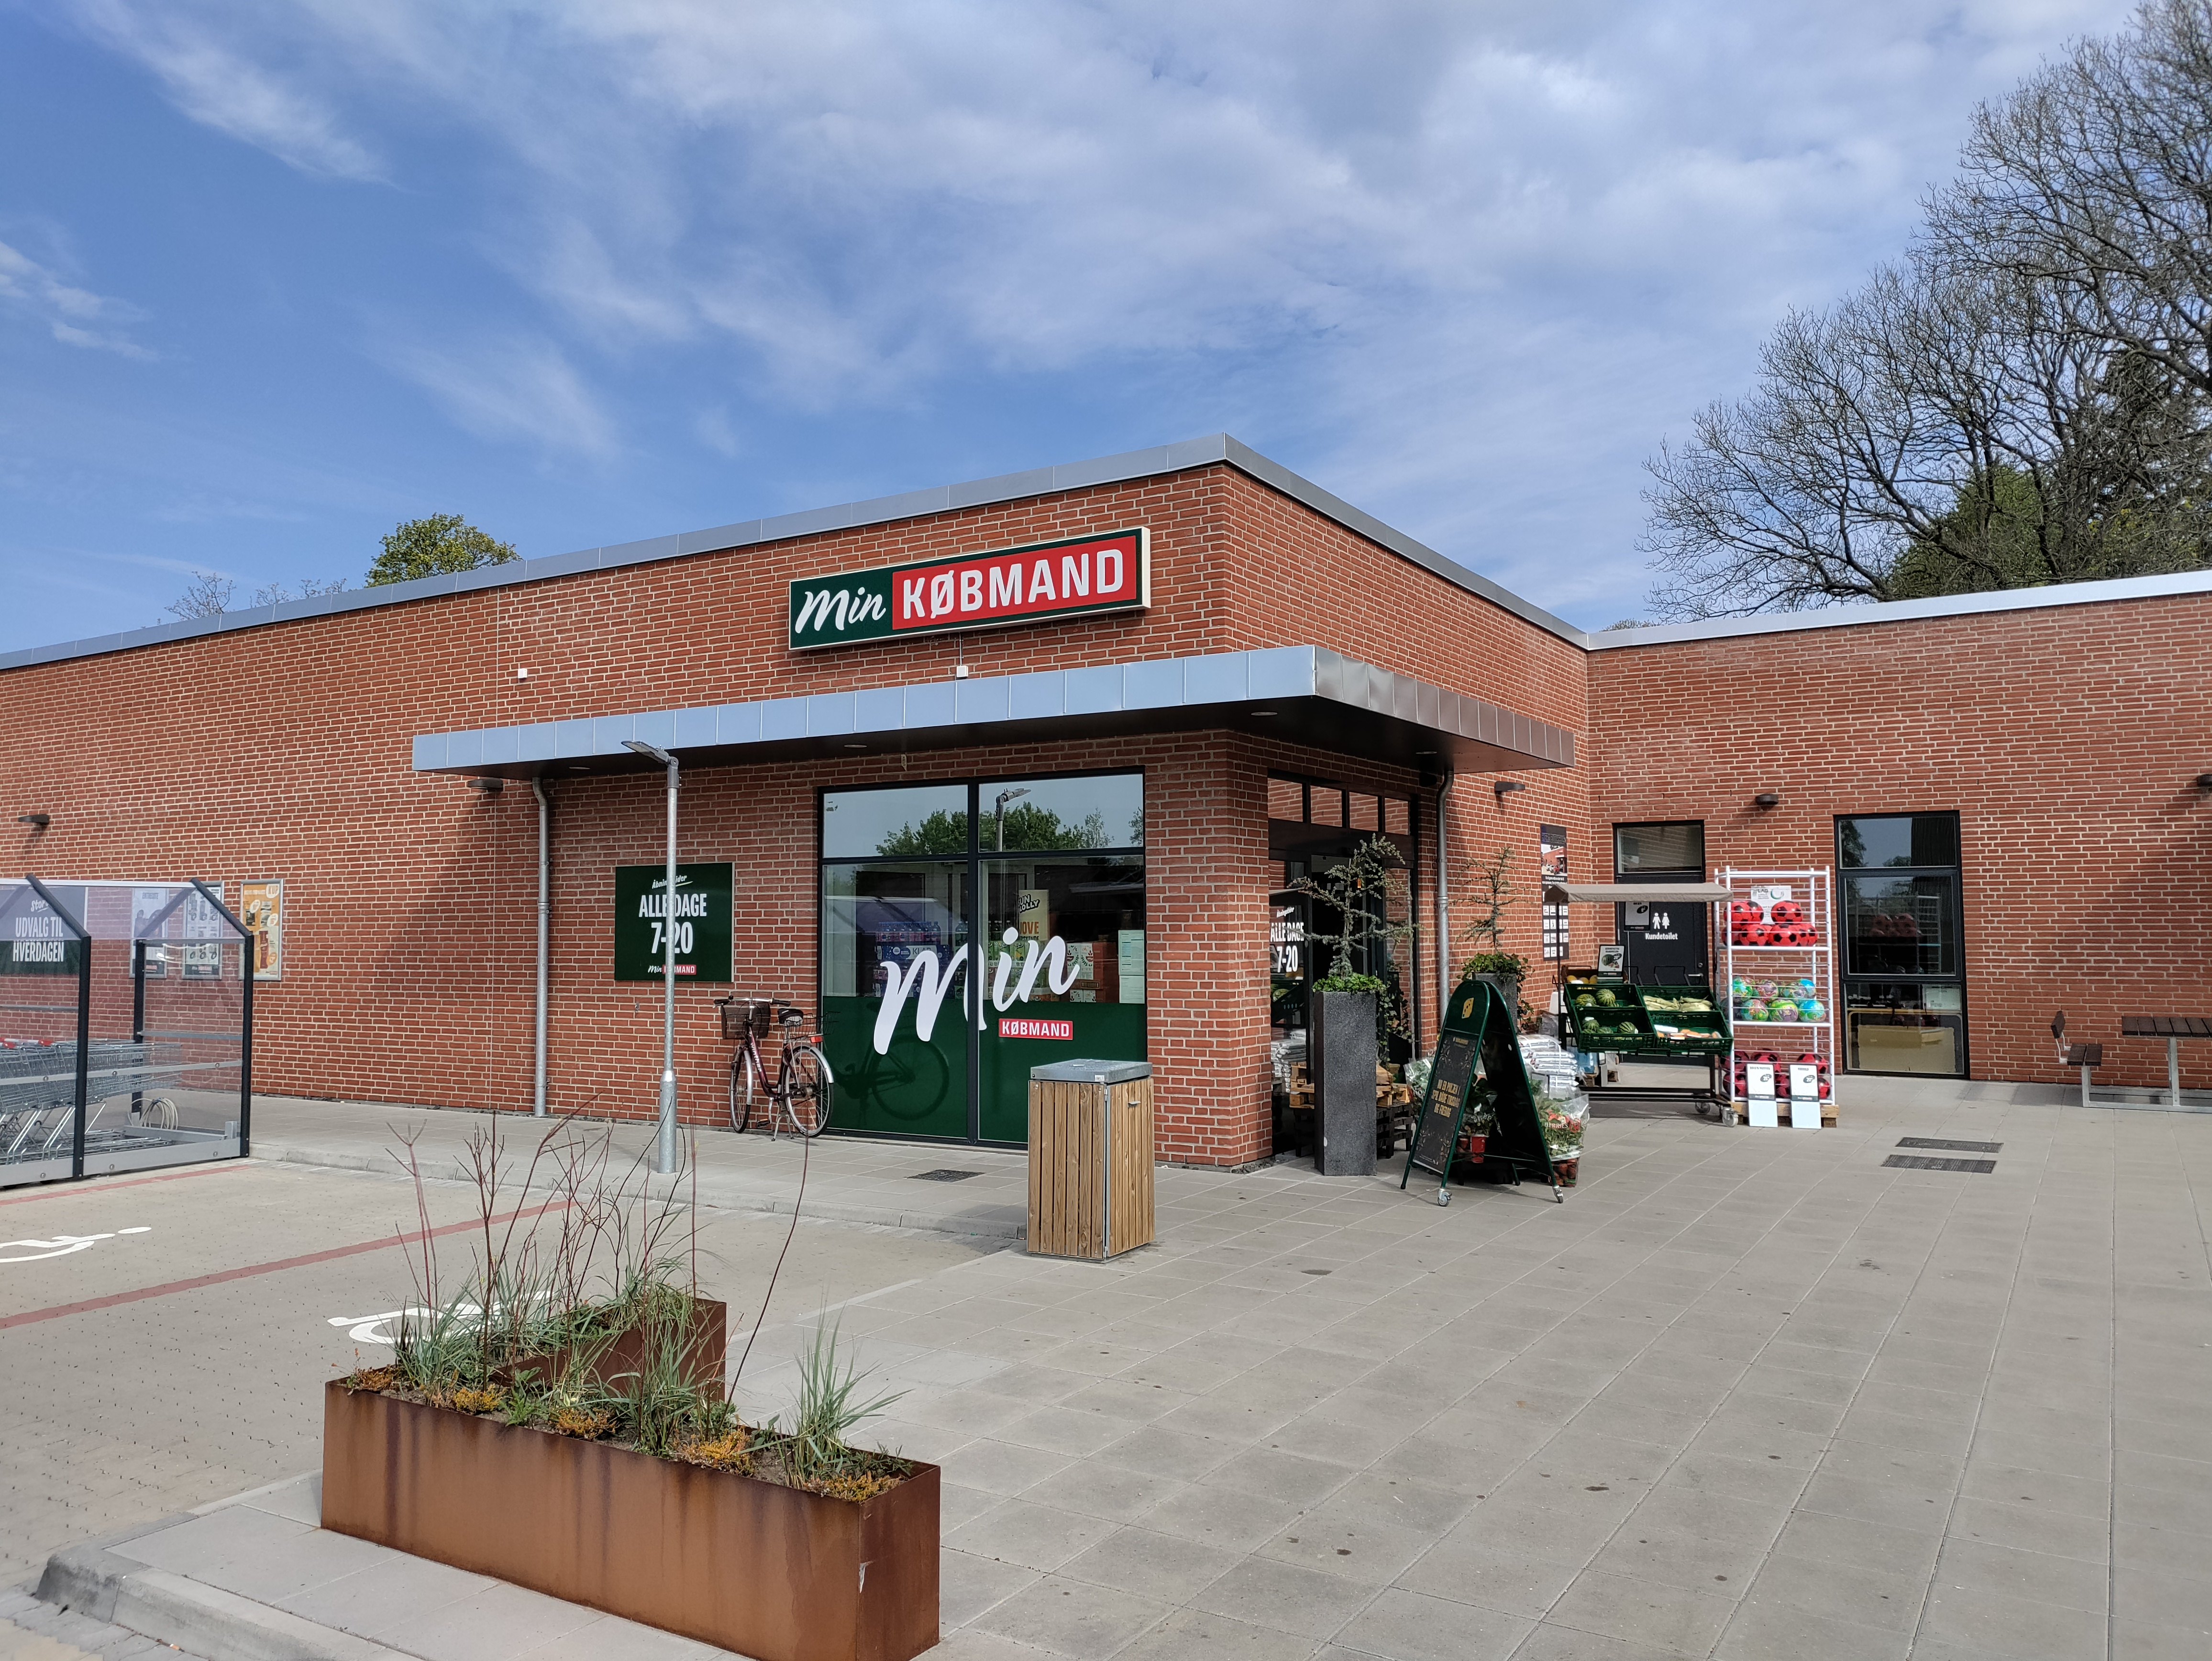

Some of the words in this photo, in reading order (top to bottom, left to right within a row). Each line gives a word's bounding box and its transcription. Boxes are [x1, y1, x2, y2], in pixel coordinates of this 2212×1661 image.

[795, 587, 886, 634] Min
[903, 549, 1123, 620] KØBMAND
[268, 885, 278, 895] KUP
[652, 875, 687, 889] Åbninider
[1019, 899, 1040, 912] LOLLY
[15, 917, 48, 938] UDVALG
[51, 917, 64, 938] TIL
[1270, 922, 1286, 942] ALLE
[1645, 932, 1678, 940] Kundetoilet
[13, 940, 65, 962] HVERDAGEN
[1276, 945, 1298, 973] 7-20
[648, 965, 662, 974] Min
[874, 927, 1080, 1055] Min
[1002, 1021, 1069, 1037] KØBMAND
